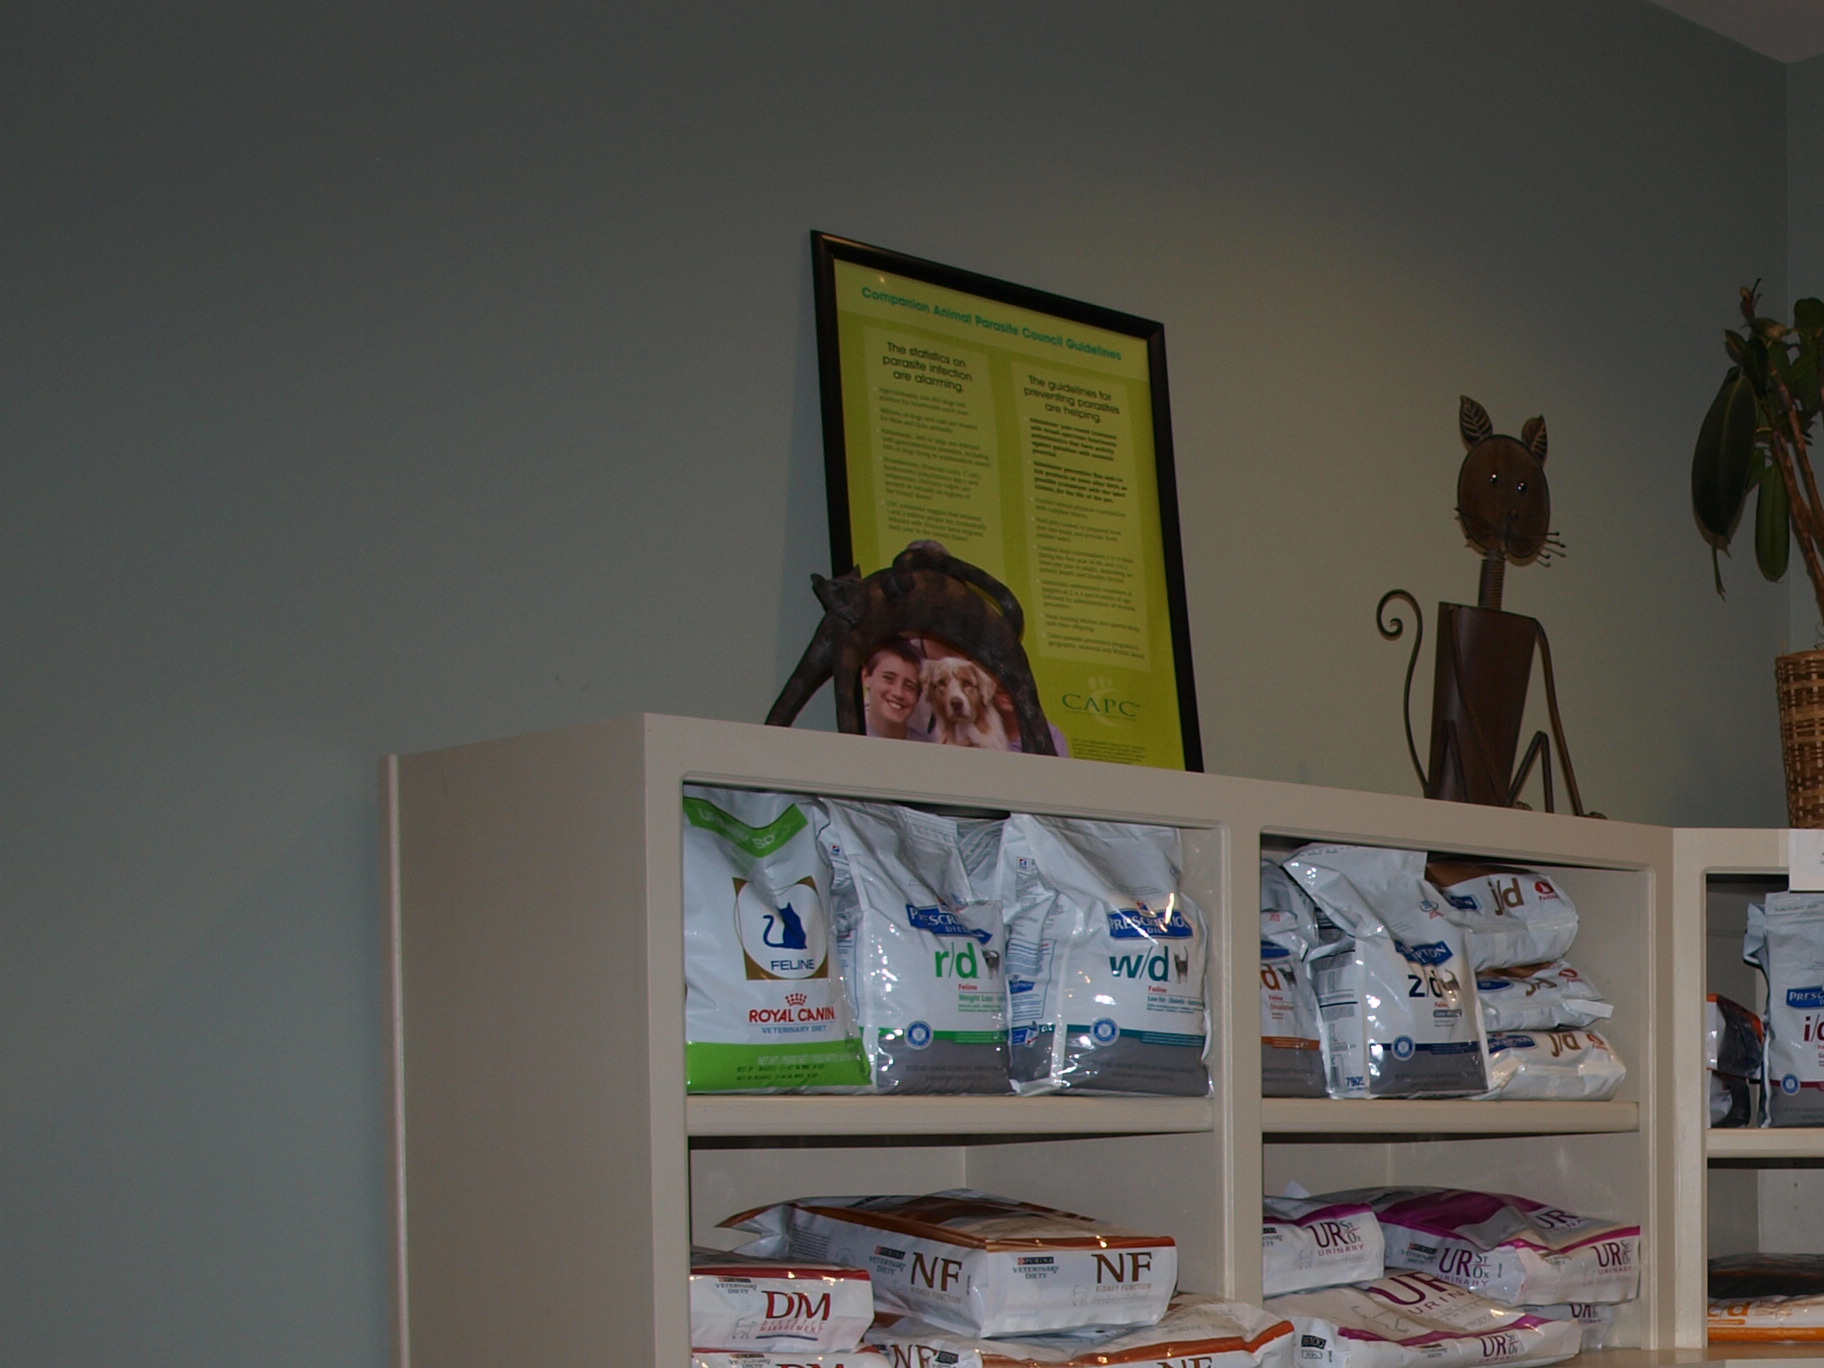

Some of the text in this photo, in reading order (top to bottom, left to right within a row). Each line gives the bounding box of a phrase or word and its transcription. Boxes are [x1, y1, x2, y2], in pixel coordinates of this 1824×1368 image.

[862, 286, 1122, 362] Companion Animal Parasite Council Guidelines
[886, 340, 966, 368] The statistics on
[882, 354, 972, 382] parasite infection
[892, 370, 964, 394] are alarming
[1028, 374, 1112, 400] The guidelines for
[1024, 386, 1120, 414] preventing parasites
[1044, 402, 1100, 424] are helping
[1062, 692, 1138, 718] CAPC
[770, 958, 816, 971] FELINE
[934, 942, 978, 980] r/d
[1109, 946, 1169, 982] w/d
[958, 982, 978, 990] Feline
[748, 1006, 836, 1024] ROYAL CANIN
[762, 1024, 828, 1034] VETERINARY DIET
[1536, 1210, 1577, 1230] UR
[1308, 1222, 1349, 1249] UR
[1318, 1242, 1364, 1257] URINARY
[1438, 1247, 1473, 1278] UR
[1592, 1242, 1621, 1268] UR
[910, 1252, 962, 1292] NF
[1012, 1266, 1059, 1274] VETERINARY
[1024, 1272, 1047, 1280] DIETS
[1090, 1252, 1152, 1284] NF
[1436, 1274, 1490, 1288] URINARY
[761, 1290, 831, 1322] DM
[1482, 1335, 1507, 1358] UR
